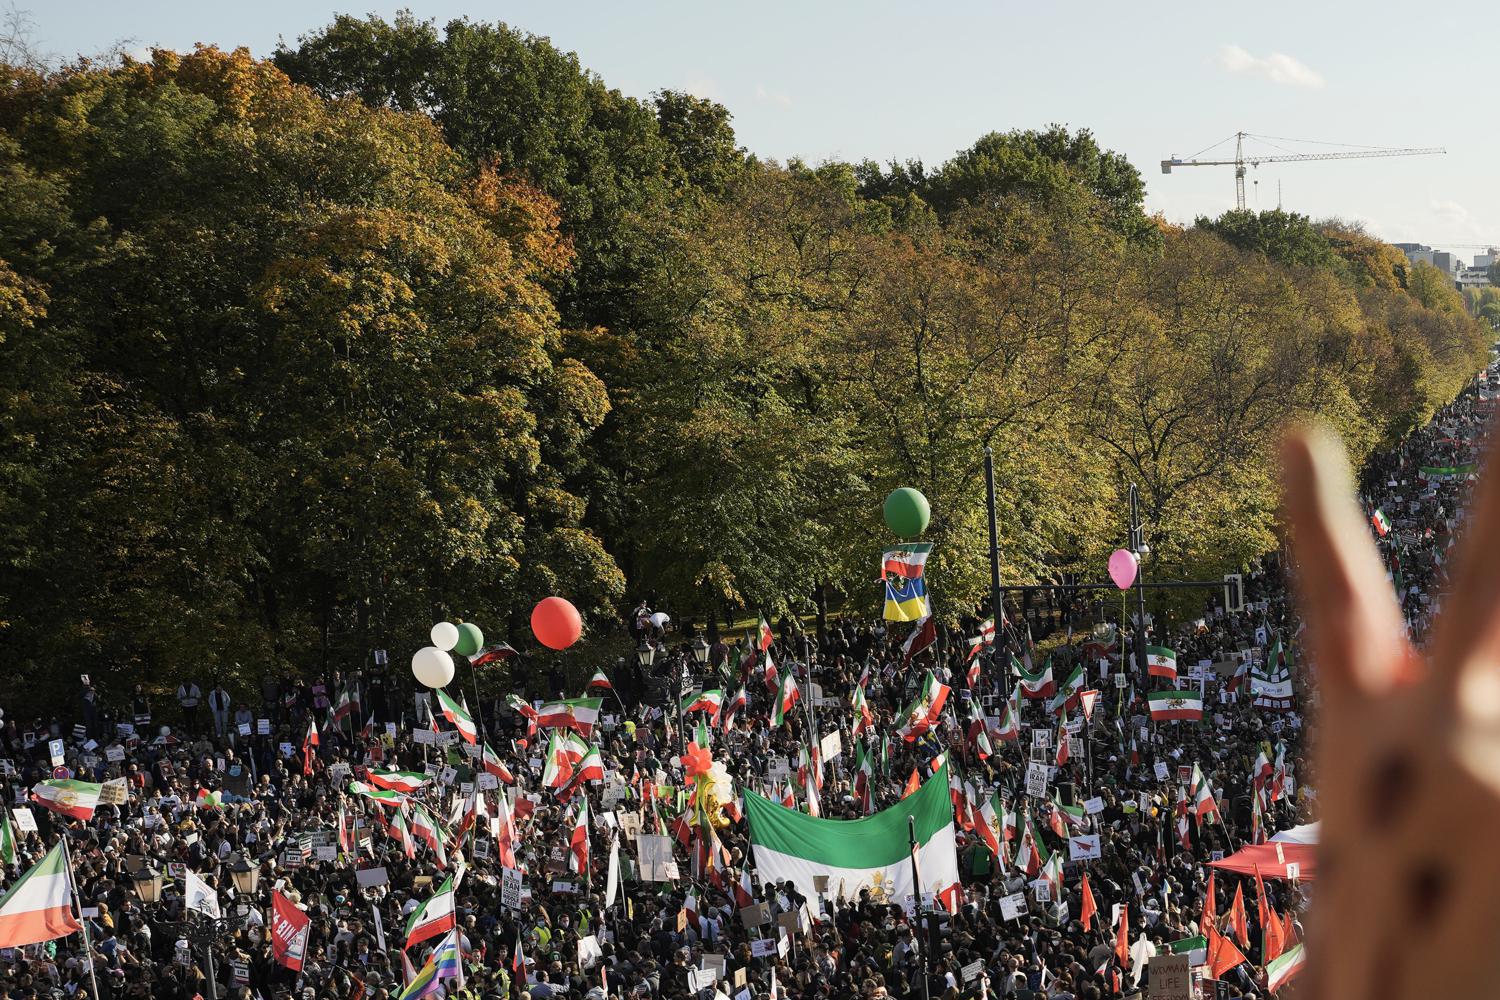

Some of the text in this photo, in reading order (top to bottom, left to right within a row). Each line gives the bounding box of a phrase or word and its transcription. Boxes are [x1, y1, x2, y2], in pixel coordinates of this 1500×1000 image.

[1030, 773, 1045, 783] IRAN
[1150, 964, 1188, 976] WOMAN
[1160, 976, 1180, 990] LIFE
